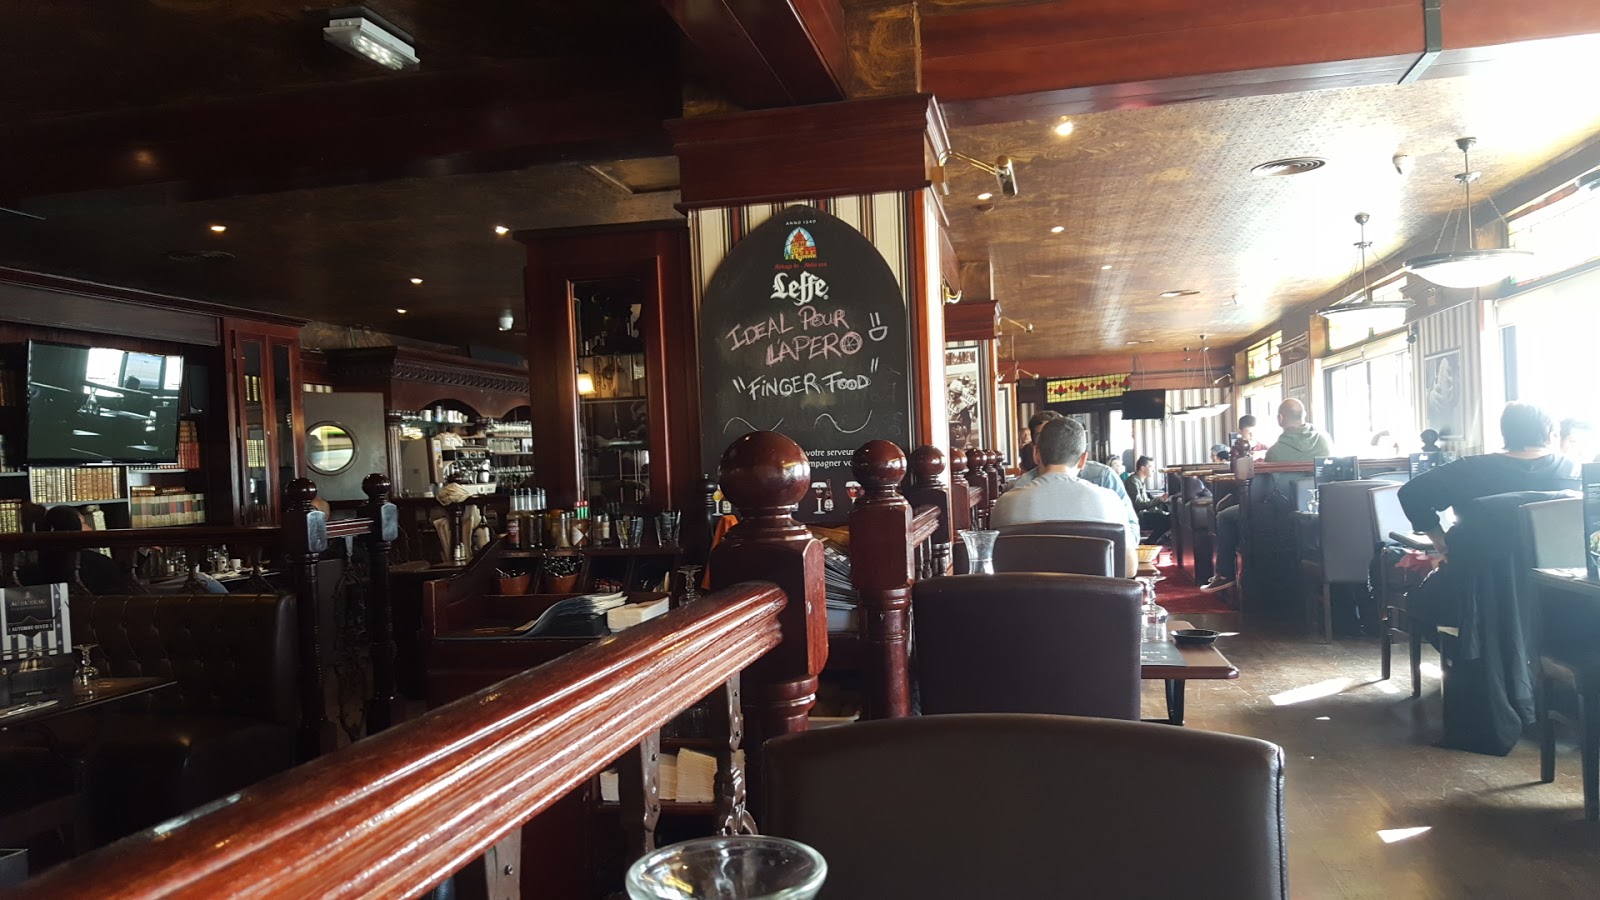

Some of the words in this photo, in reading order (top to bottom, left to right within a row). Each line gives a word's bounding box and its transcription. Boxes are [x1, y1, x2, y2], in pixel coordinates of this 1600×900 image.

[770, 270, 829, 306] Leffe
[725, 312, 794, 351] IDEAL
[798, 305, 850, 331] POUR
[805, 449, 825, 457] votre
[826, 449, 855, 457] serveur
[808, 460, 841, 469] mpagner
